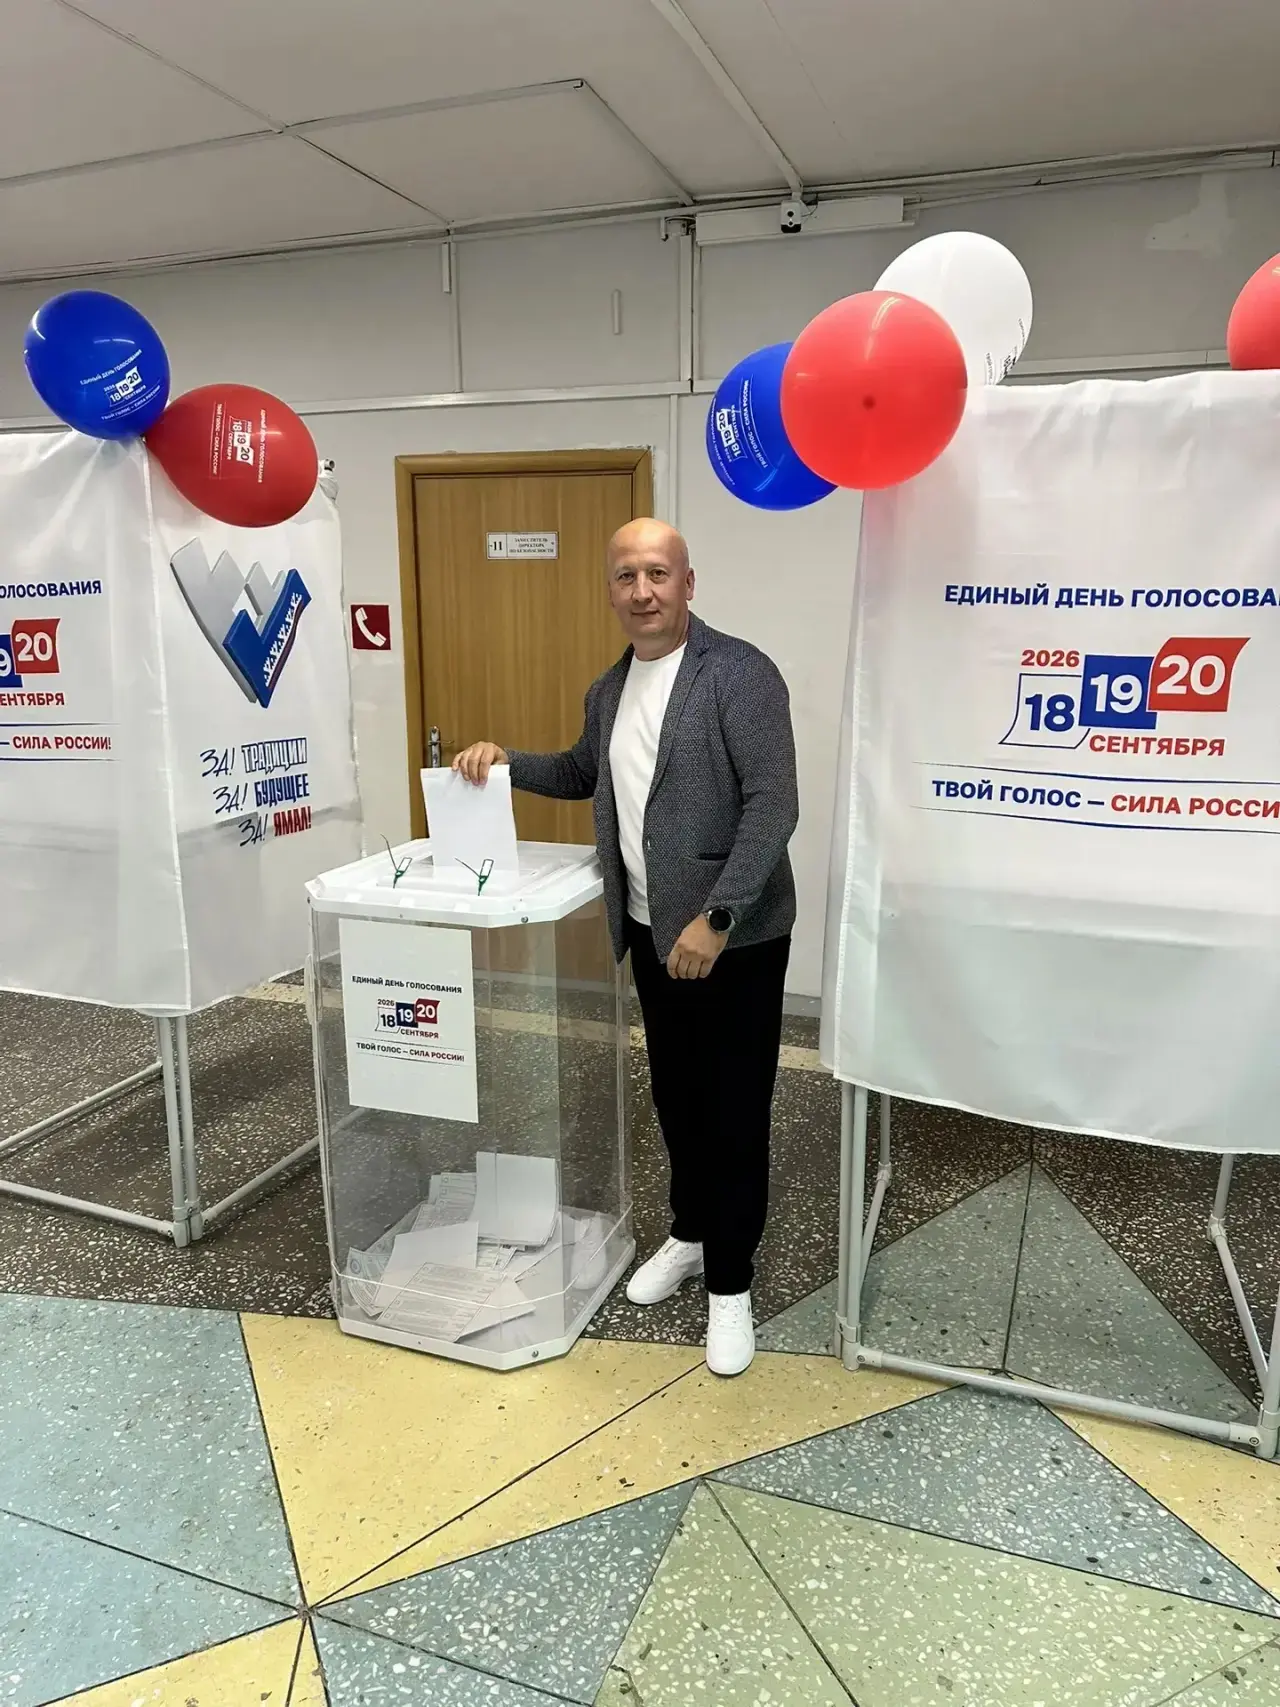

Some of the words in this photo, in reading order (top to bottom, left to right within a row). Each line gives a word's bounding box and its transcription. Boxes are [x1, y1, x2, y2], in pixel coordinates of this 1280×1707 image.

[110, 392, 121, 402] 18
[119, 383, 130, 394] 19
[128, 372, 139, 384] 20
[232, 421, 243, 432] 18
[718, 412, 726, 429] 20
[237, 434, 246, 444] 19
[724, 430, 733, 444] 19
[240, 446, 250, 460] 20
[732, 444, 741, 457] 18
[945, 583, 1049, 607] ЕДИНЫЙ
[1055, 588, 1124, 608] ДЕНЬ
[1132, 588, 1280, 608] ГОЛОСОВА
[15, 632, 53, 661] 20
[1021, 650, 1080, 667] 2026
[1025, 694, 1075, 732] 18
[1090, 673, 1143, 714] 19
[1156, 655, 1226, 695] 20
[13, 736, 52, 750] СИЛА
[54, 736, 112, 750] РОССИИ!
[1089, 734, 1225, 756] СЕНТЯБРЯ
[200, 747, 235, 777] ЗА!
[241, 737, 307, 775] ТРАДИЦИИ
[213, 783, 248, 814] ЗА!
[254, 773, 310, 808] БУДУЩЕЕ
[932, 779, 993, 801] ТВОЙ
[1001, 786, 1081, 808] ГОЛОС
[1111, 795, 1181, 815] СИЛА
[238, 814, 268, 847] ЗА!
[273, 806, 311, 837] ЯМАЛ!
[352, 976, 383, 985] ЕДИНЫЙ
[385, 980, 404, 988] ДЕНЬ
[406, 982, 462, 994] ГОЛОСОВАНИЯ
[380, 1014, 395, 1027] 18
[398, 1009, 413, 1022] 19
[417, 1004, 435, 1018] 20
[400, 1028, 439, 1038] СЕНТЯБРЯ
[356, 1042, 376, 1050] ТВОЙ
[377, 1045, 401, 1054] ГОЛОС
[410, 1049, 430, 1057] СИЛА
[432, 1052, 464, 1062] РОССИИ!
